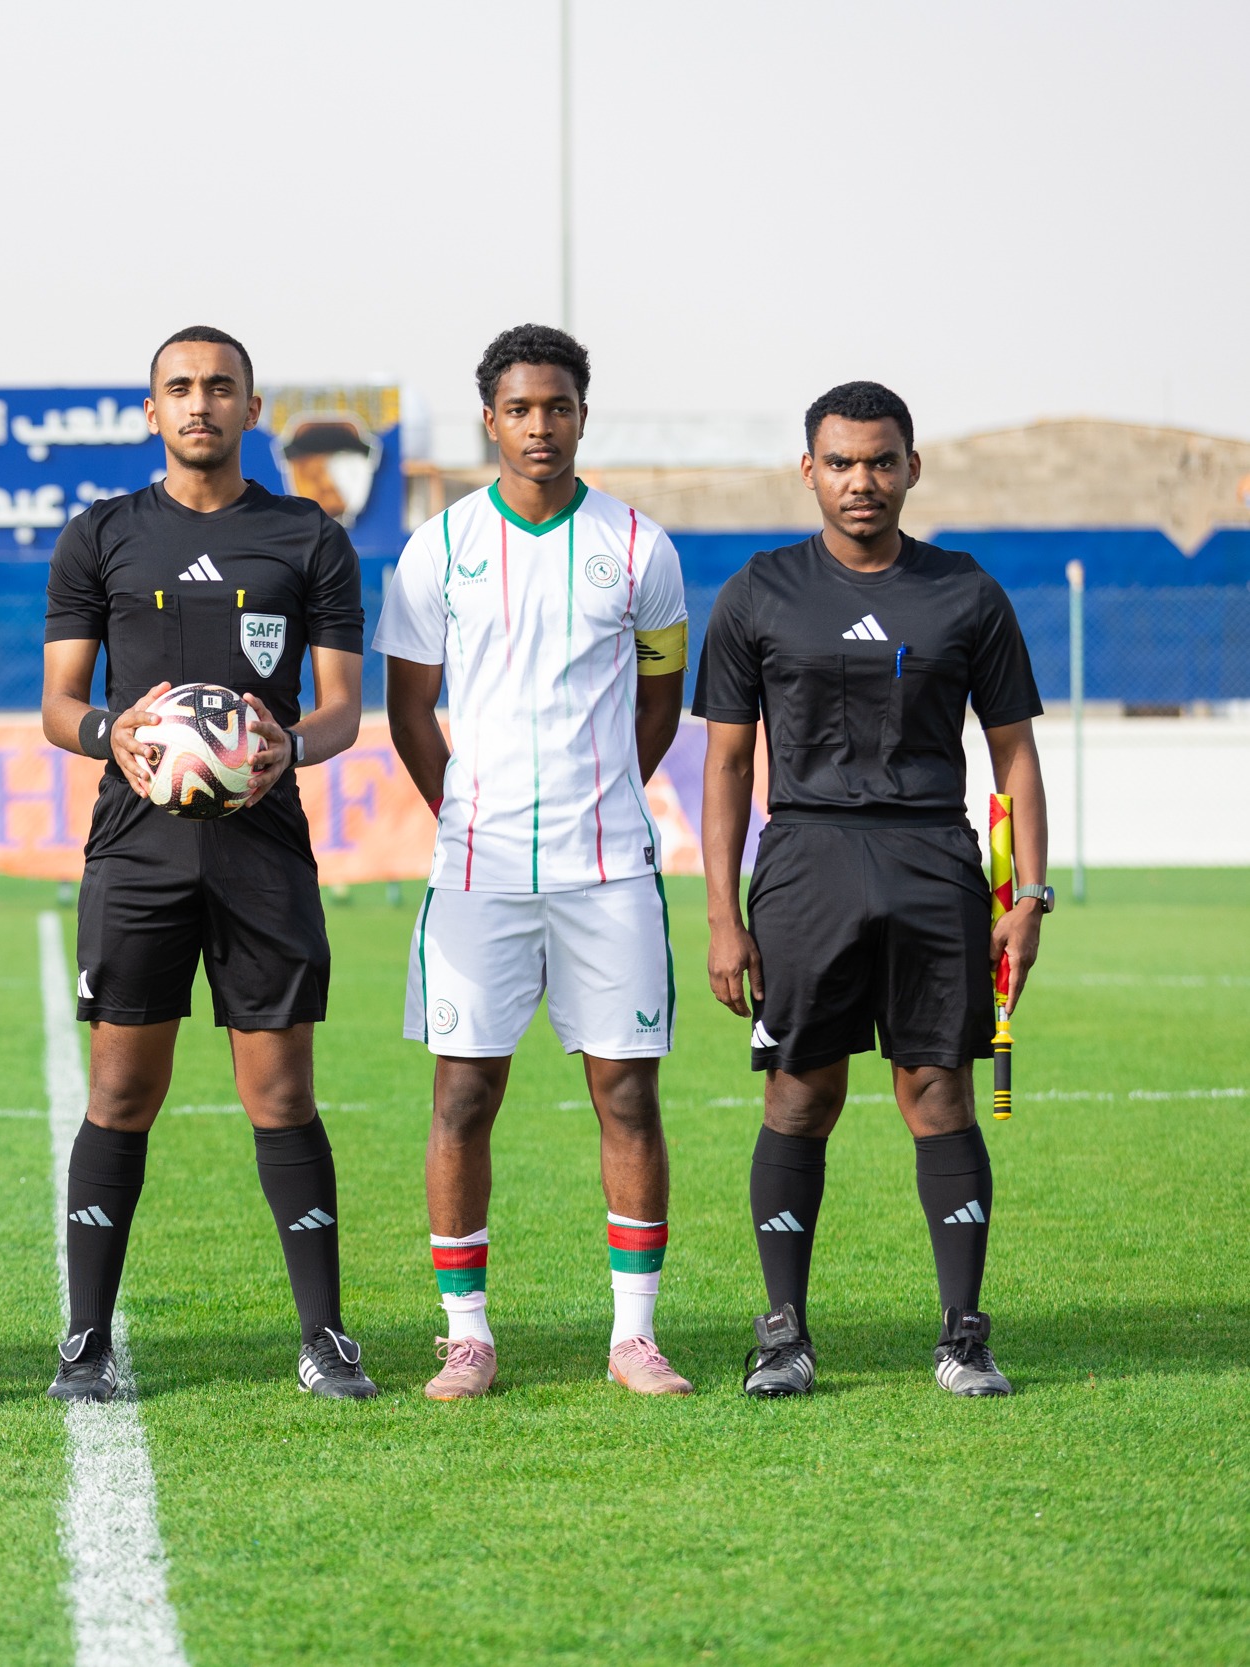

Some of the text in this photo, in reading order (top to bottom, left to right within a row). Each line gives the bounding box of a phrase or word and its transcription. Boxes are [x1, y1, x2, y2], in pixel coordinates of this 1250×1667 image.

[10, 396, 151, 463] ملعب
[246, 621, 283, 639] SAFF
[250, 640, 279, 649] REFEREE
